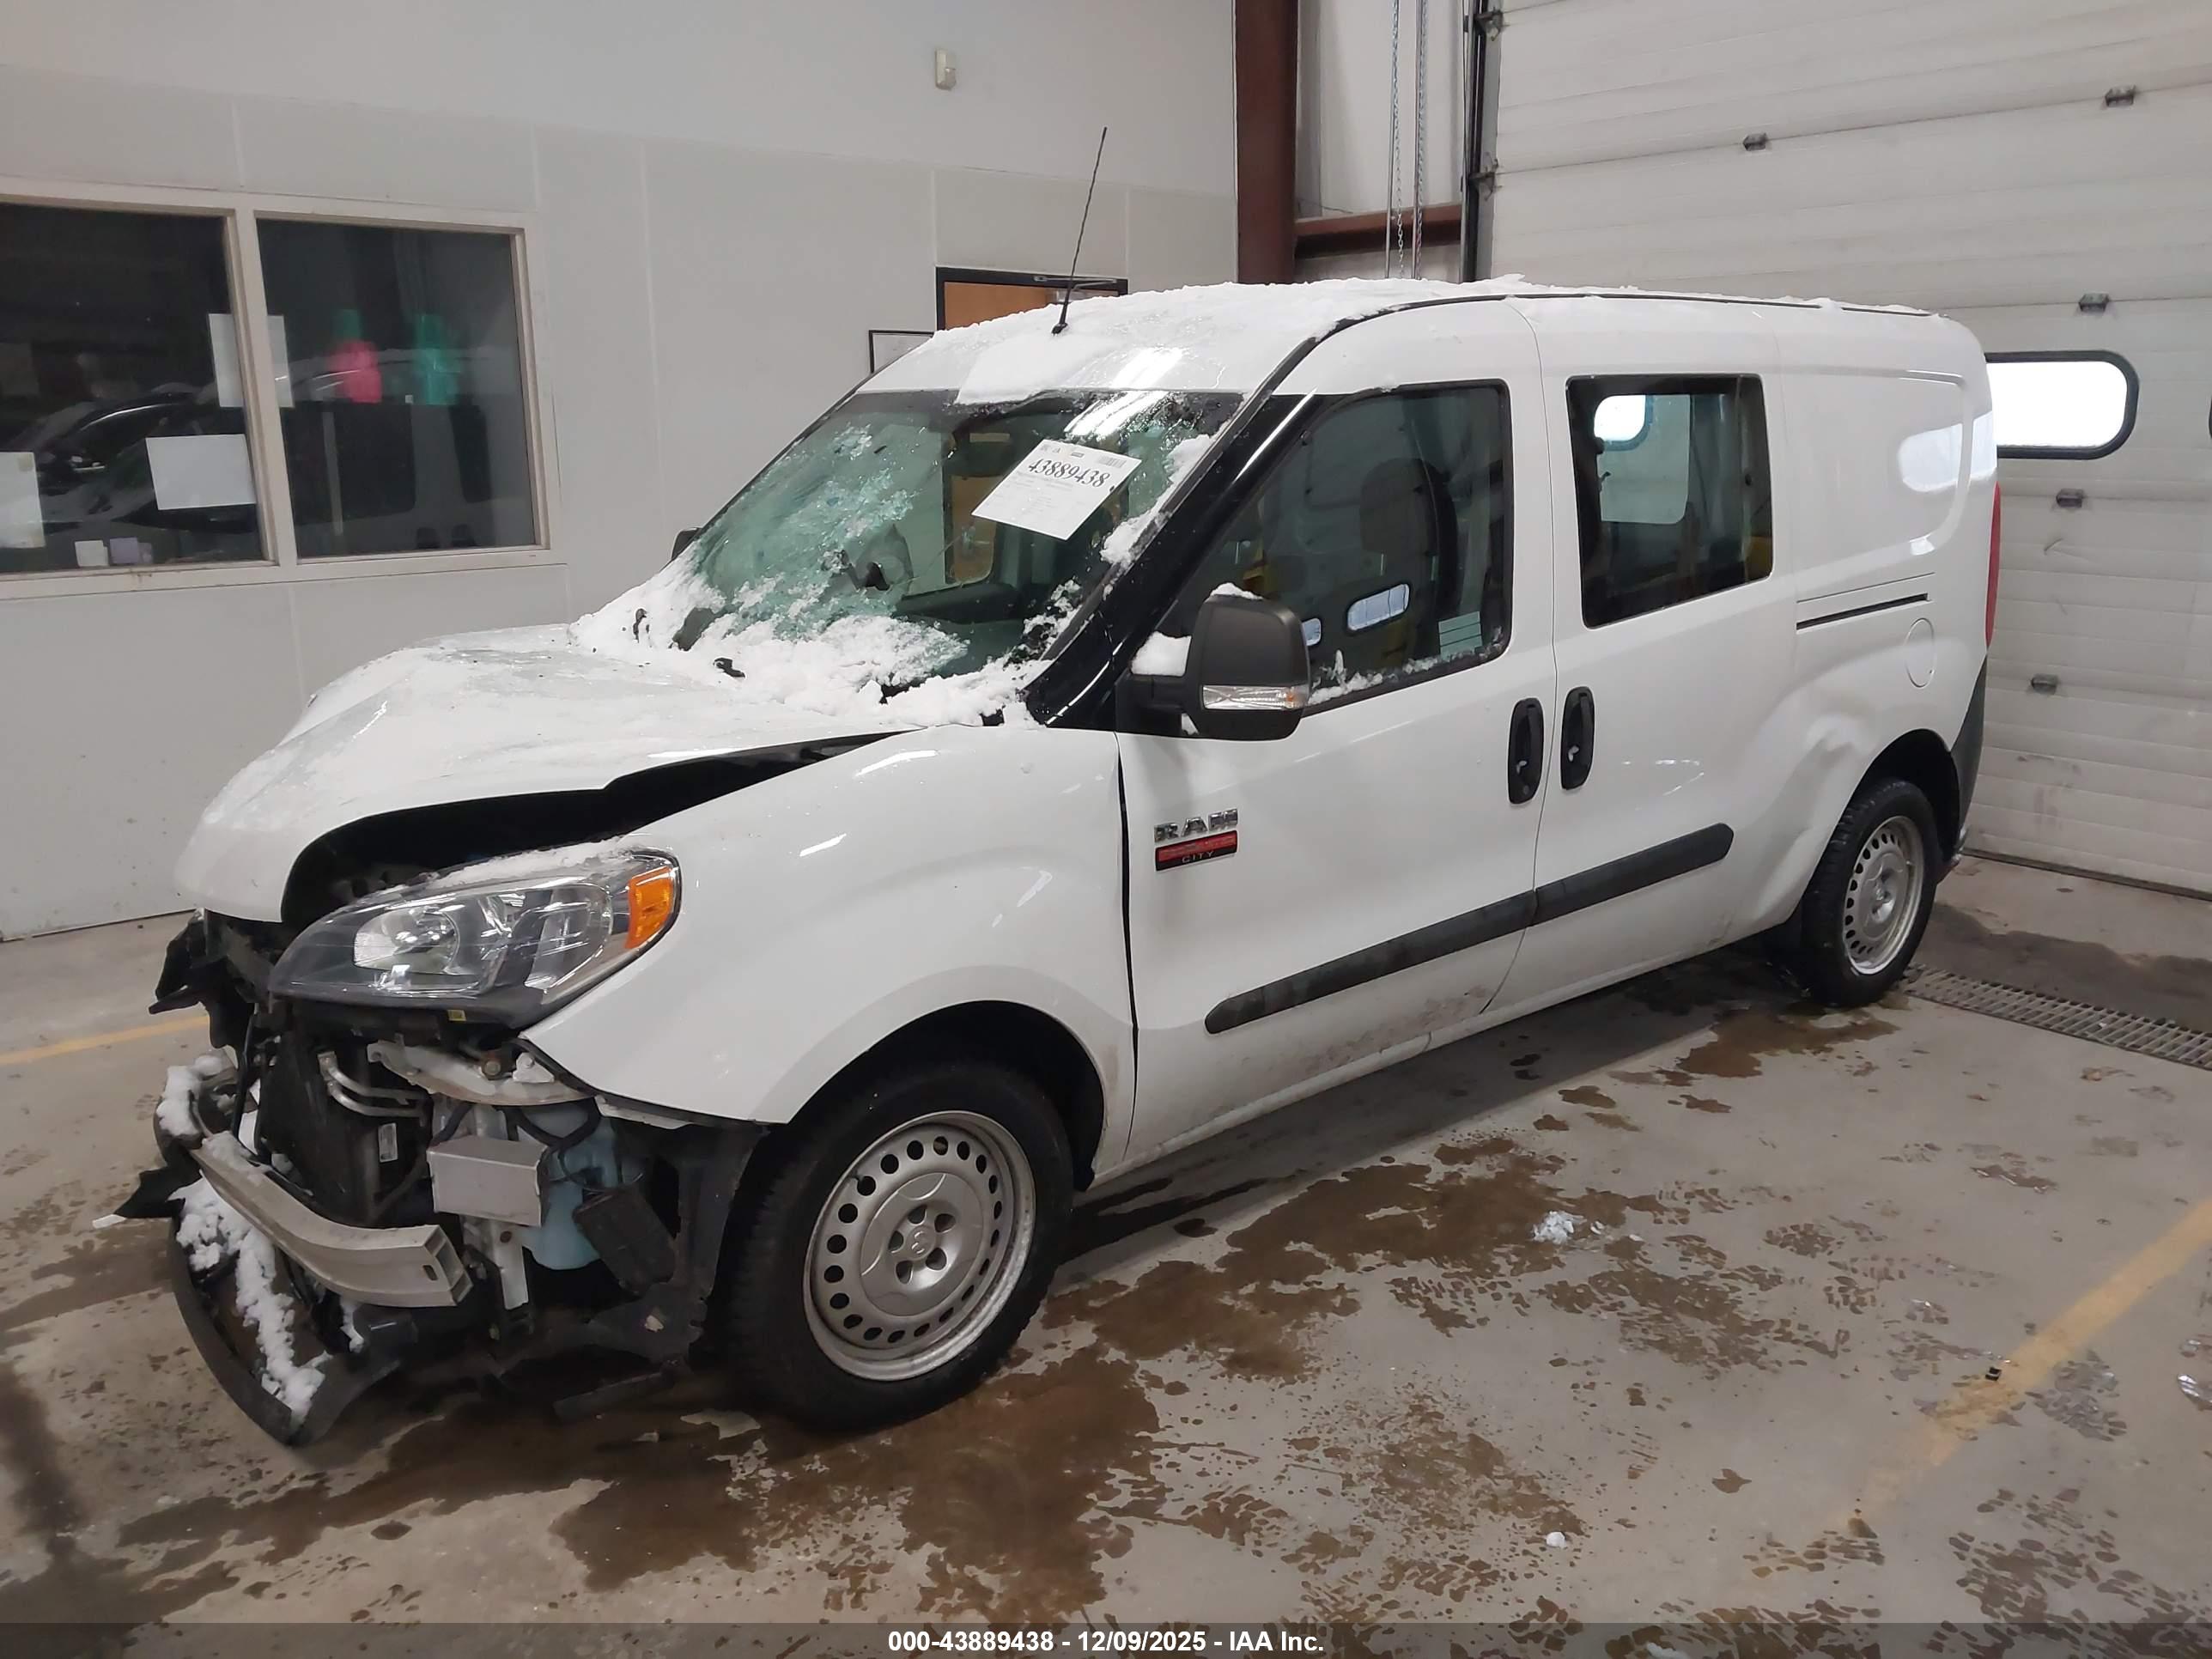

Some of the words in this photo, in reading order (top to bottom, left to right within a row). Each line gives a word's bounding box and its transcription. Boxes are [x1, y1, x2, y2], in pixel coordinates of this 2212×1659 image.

[1028, 459, 1110, 487] 43889438
[1154, 808, 1238, 842] RAM
[1182, 850, 1214, 863] CITY
